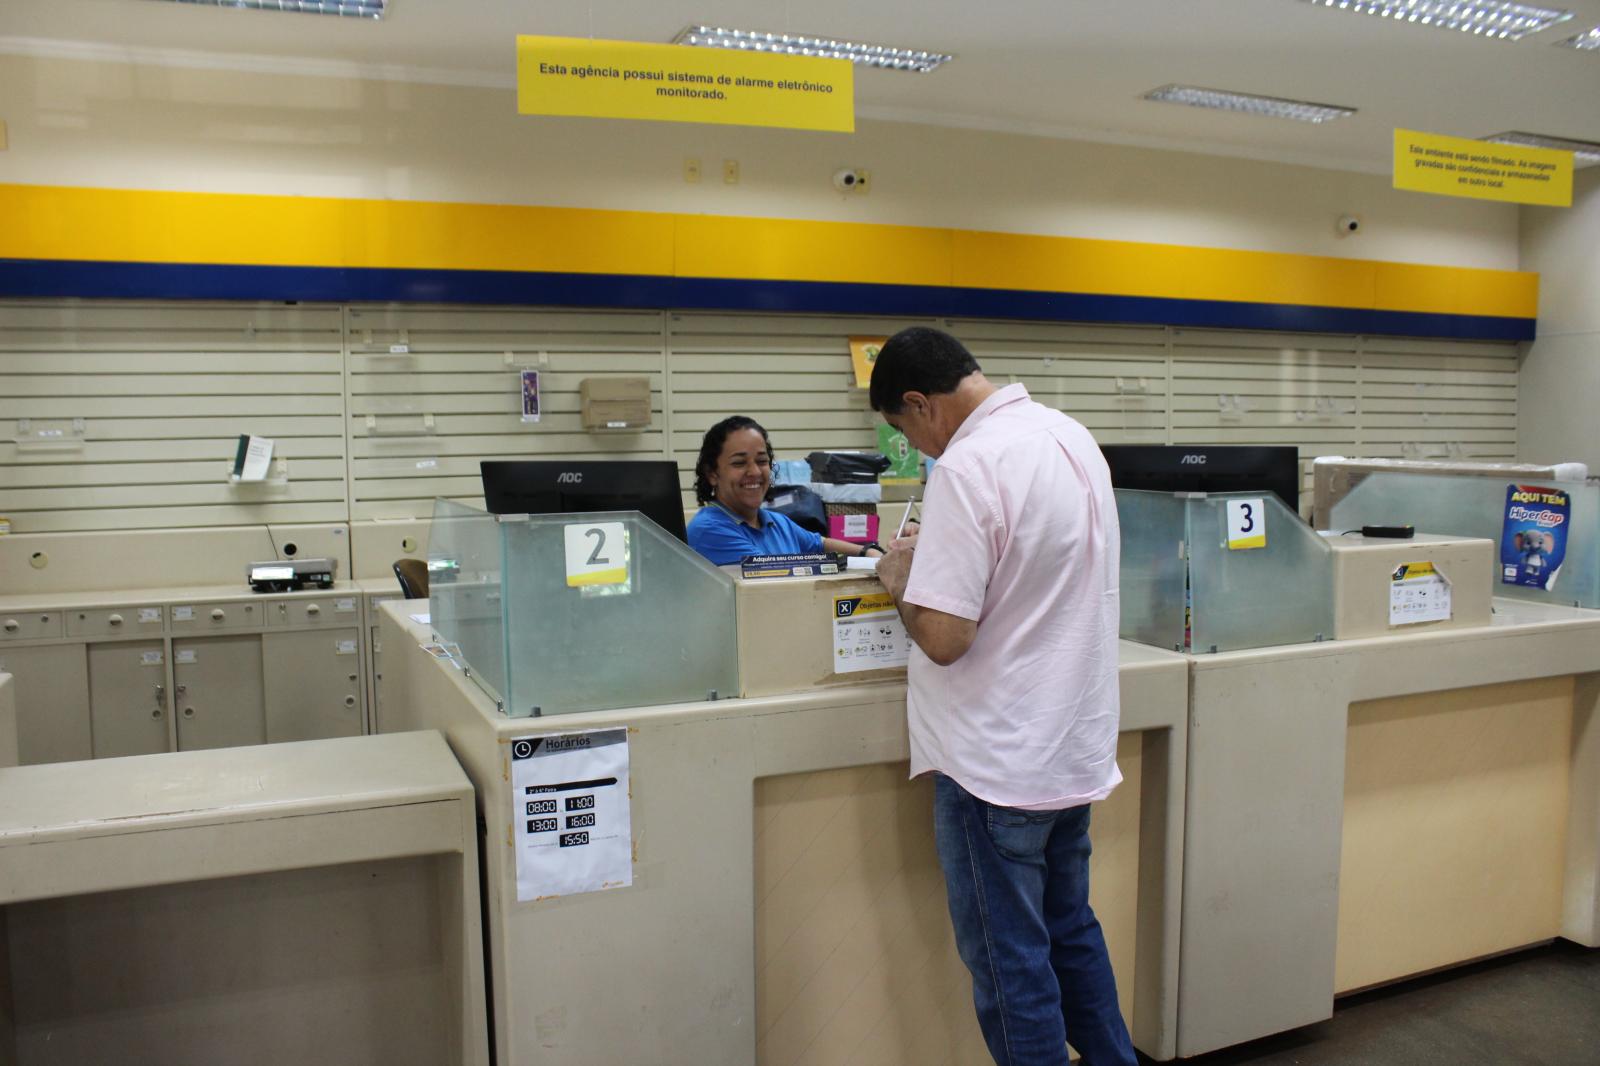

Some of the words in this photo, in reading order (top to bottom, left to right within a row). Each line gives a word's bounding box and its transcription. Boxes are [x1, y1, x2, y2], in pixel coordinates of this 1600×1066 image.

[540, 63, 567, 75] Esta
[571, 64, 620, 78] agência
[623, 69, 664, 81] possui
[668, 71, 713, 84] sistema
[717, 74, 731, 85] de
[735, 76, 774, 88] alarme
[777, 80, 833, 93] eletrônico
[656, 86, 727, 100] monitorado.
[1410, 144, 1423, 154] Este
[1425, 148, 1454, 159] ambiente
[1470, 155, 1490, 164] sendo
[1528, 161, 1556, 172] imagens
[1415, 158, 1444, 169] gravadas
[1445, 163, 1457, 171] são
[1457, 165, 1500, 176] confidenciais
[1507, 171, 1551, 181] armazenadas
[1469, 178, 1486, 187] outro
[1181, 454, 1207, 464] AOC
[557, 472, 582, 483] AOC
[1511, 492, 1540, 503] AQUI
[1541, 494, 1566, 506] TEM
[1240, 503, 1254, 533] 3
[585, 528, 610, 565] 2
[805, 553, 827, 561] comigo!
[546, 736, 591, 750] Horários
[528, 801, 556, 813] 08:00
[571, 797, 593, 809] 11:00
[532, 819, 556, 831] 13:00
[571, 814, 594, 827] 16:00
[564, 833, 588, 846] 15:50
